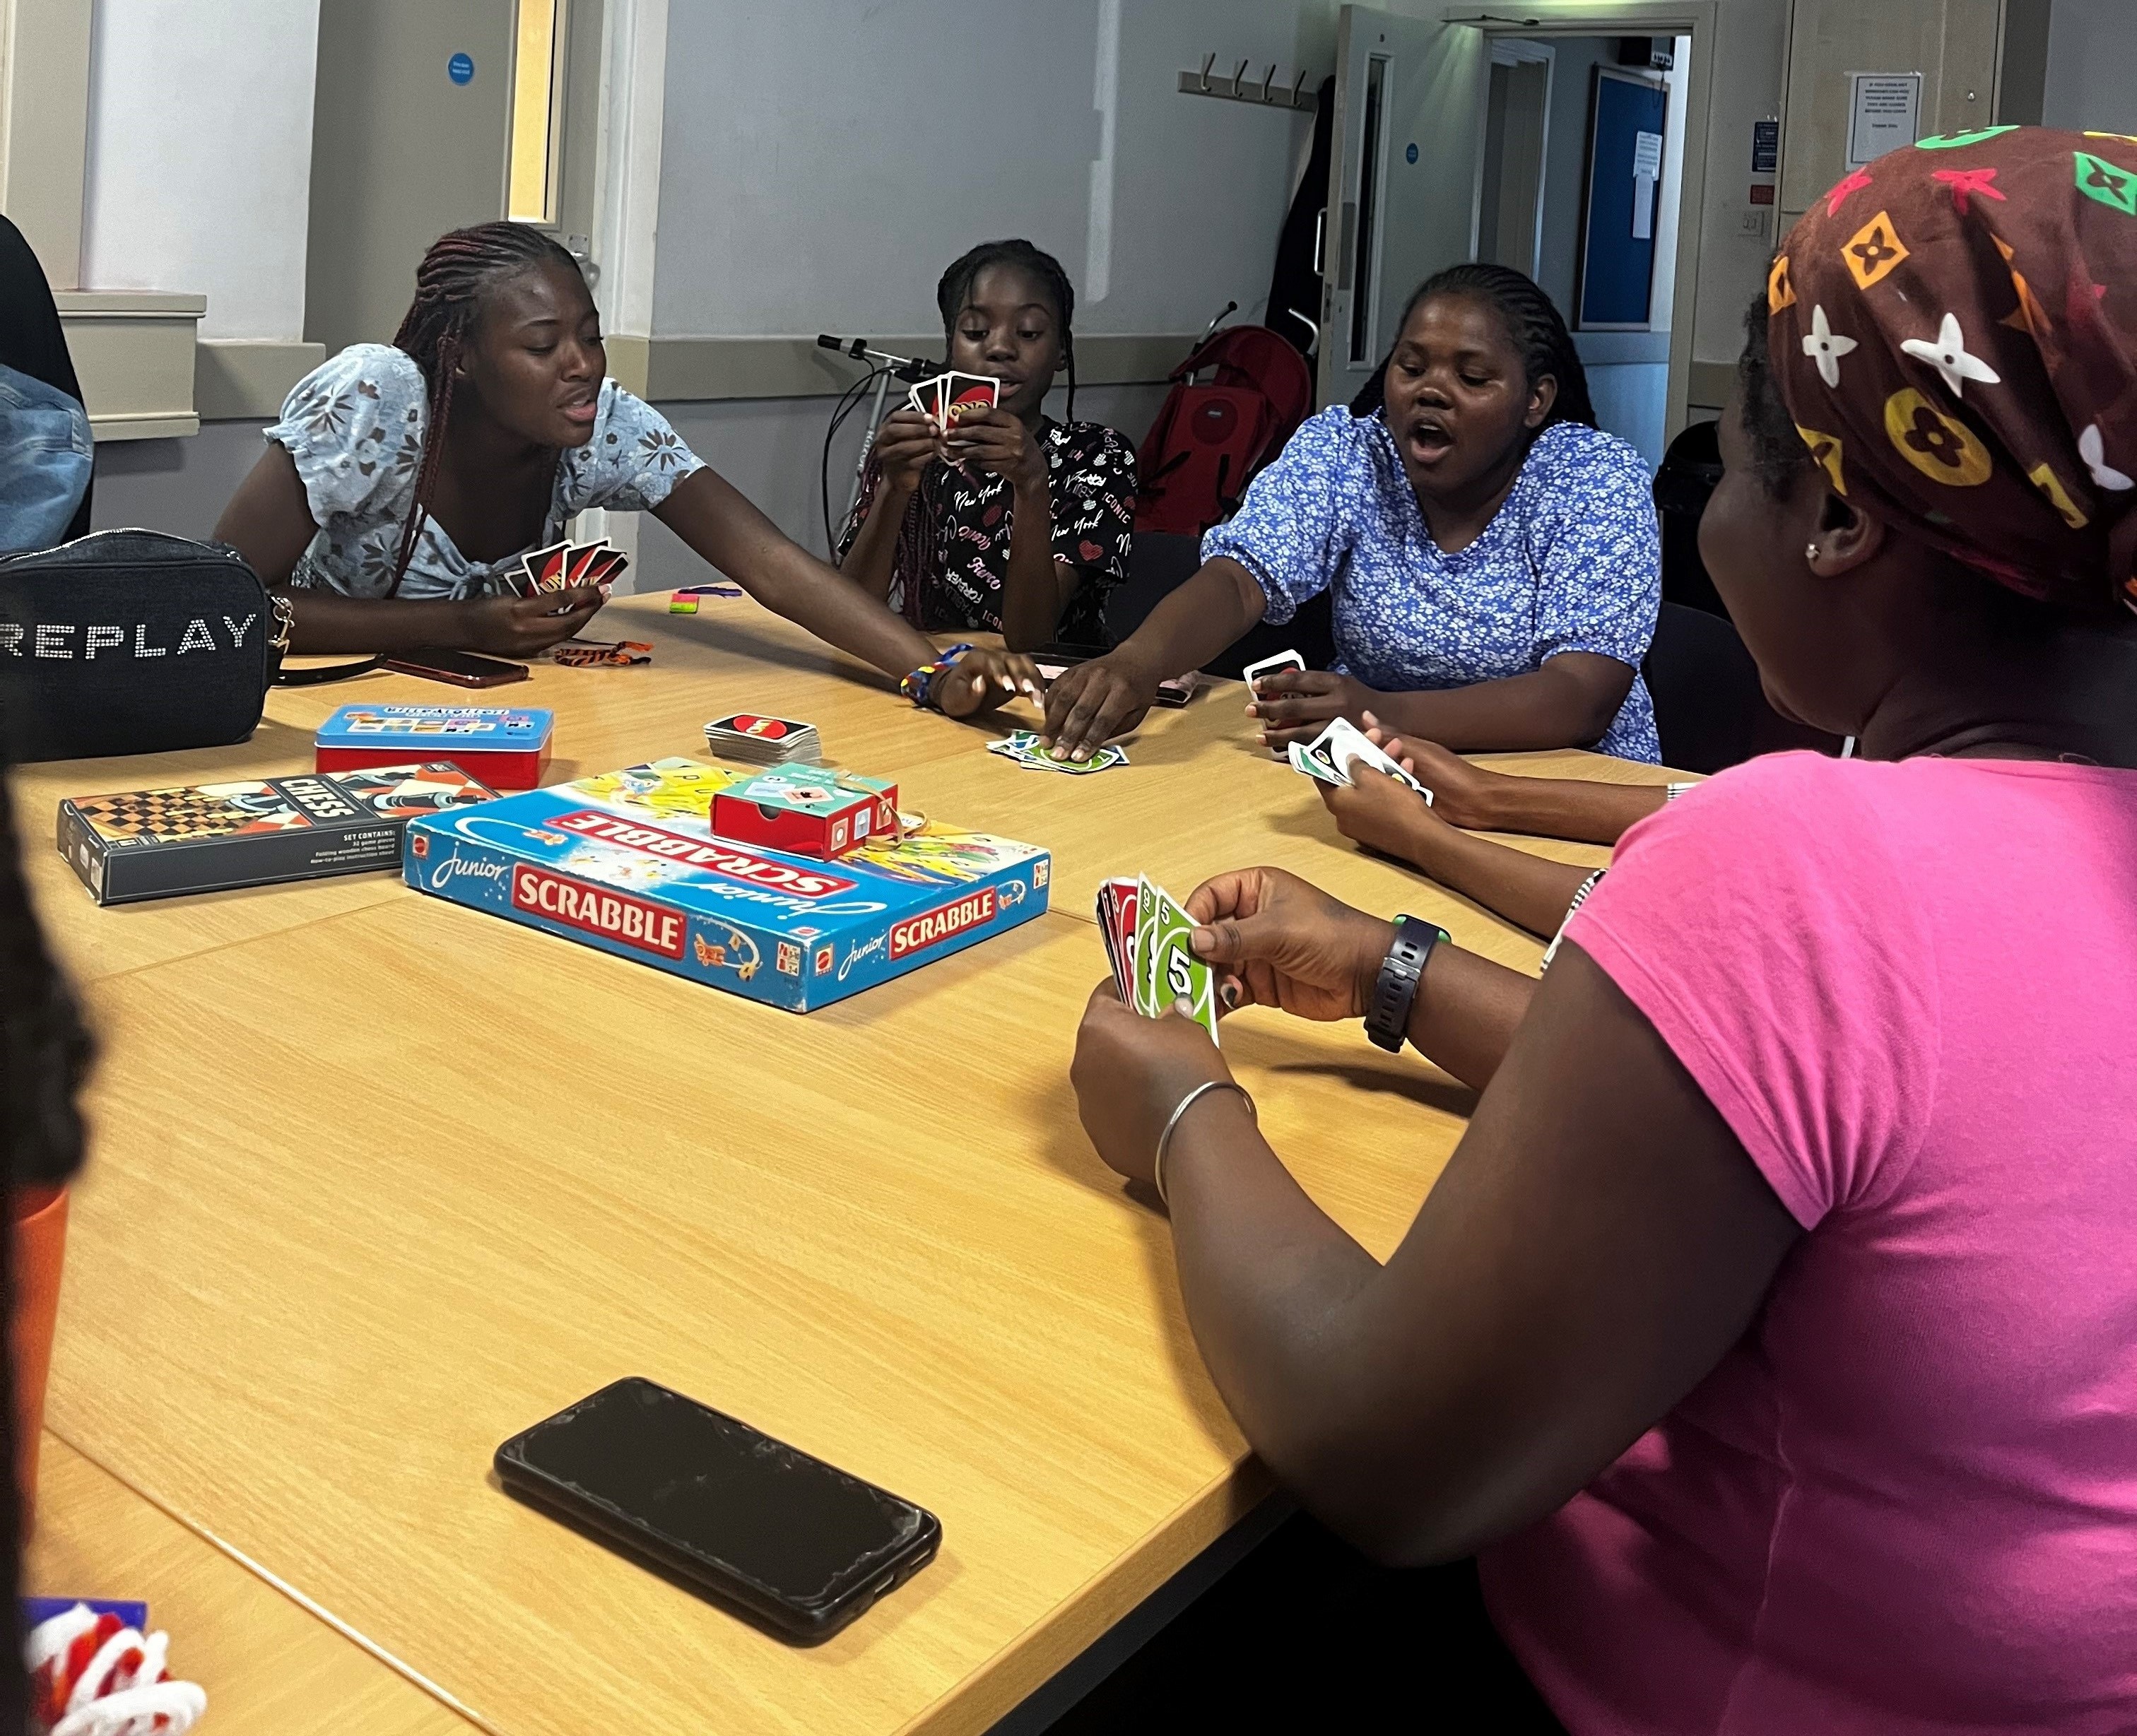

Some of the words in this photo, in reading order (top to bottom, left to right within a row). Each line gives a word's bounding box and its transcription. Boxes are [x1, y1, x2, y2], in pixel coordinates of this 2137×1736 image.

[1074, 509, 1103, 535] York
[1102, 492, 1131, 524] ICONIC
[945, 568, 983, 604] FOREVER
[0, 614, 256, 659] REPLAY
[280, 779, 354, 817] CHESS
[562, 815, 839, 892] SCRABBLE
[519, 873, 679, 950] SCRABBLE
[894, 893, 993, 953] SCRABBLE
[1161, 902, 1170, 925] 5
[1167, 944, 1193, 996] 5
